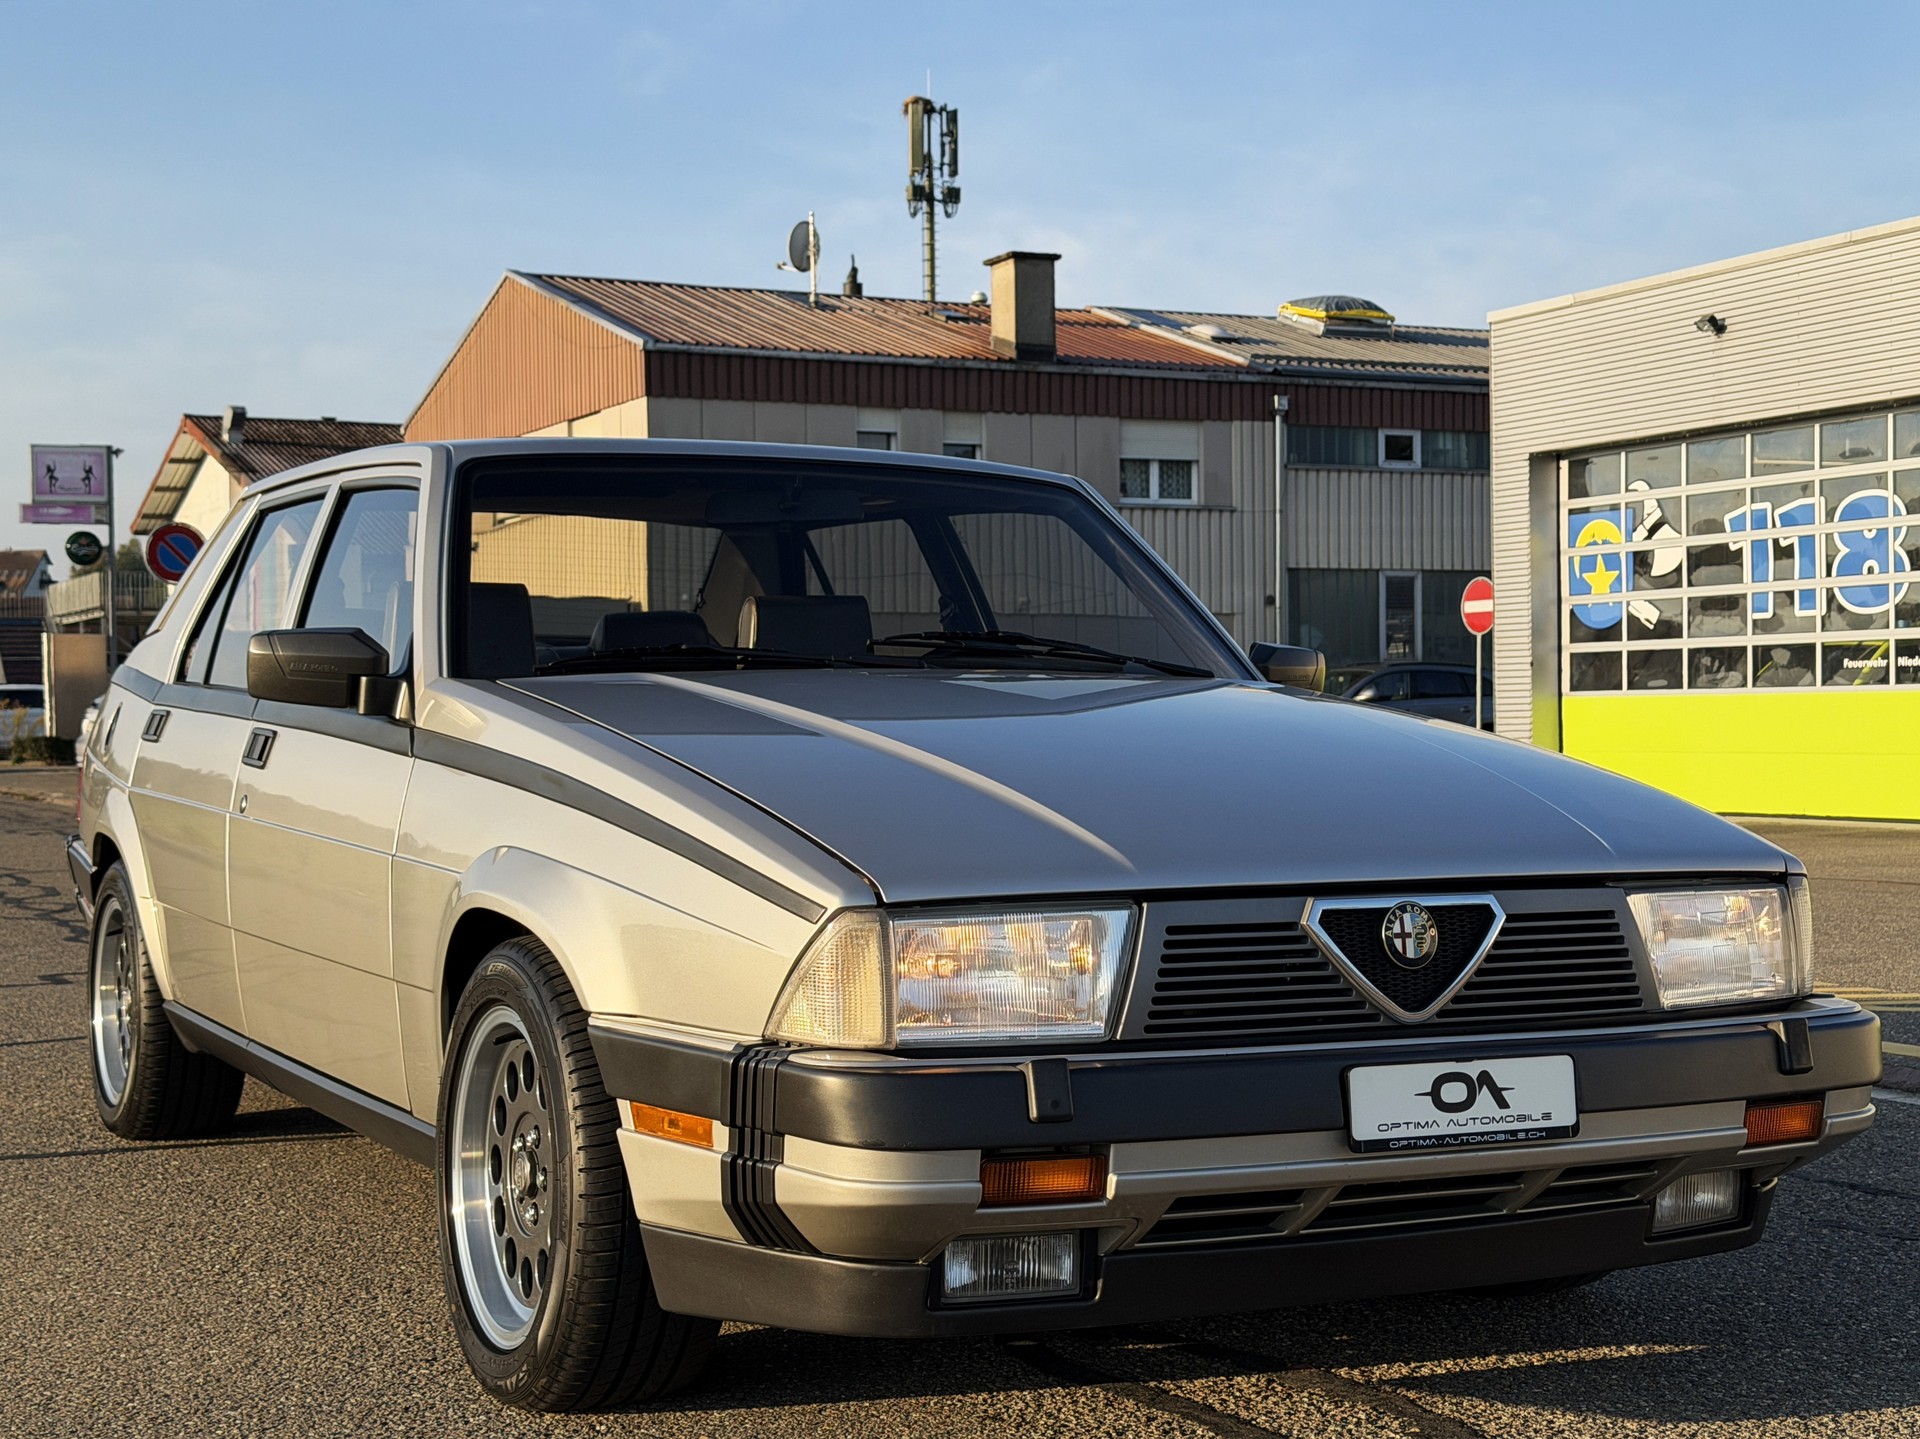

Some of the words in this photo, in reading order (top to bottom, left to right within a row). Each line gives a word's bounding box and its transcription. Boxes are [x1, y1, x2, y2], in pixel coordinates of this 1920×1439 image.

[1723, 488, 1911, 620] 118
[1843, 657, 1888, 669] Feuerwehr
[1385, 909, 1403, 938] ALFA
[1406, 904, 1436, 936] ROMEO
[1377, 1121, 1440, 1132] OPTIMA
[1446, 1113, 1553, 1127] AUTOMOBILE
[1389, 1131, 1546, 1148] OPTIMA-AUTOMOBILE.CH
